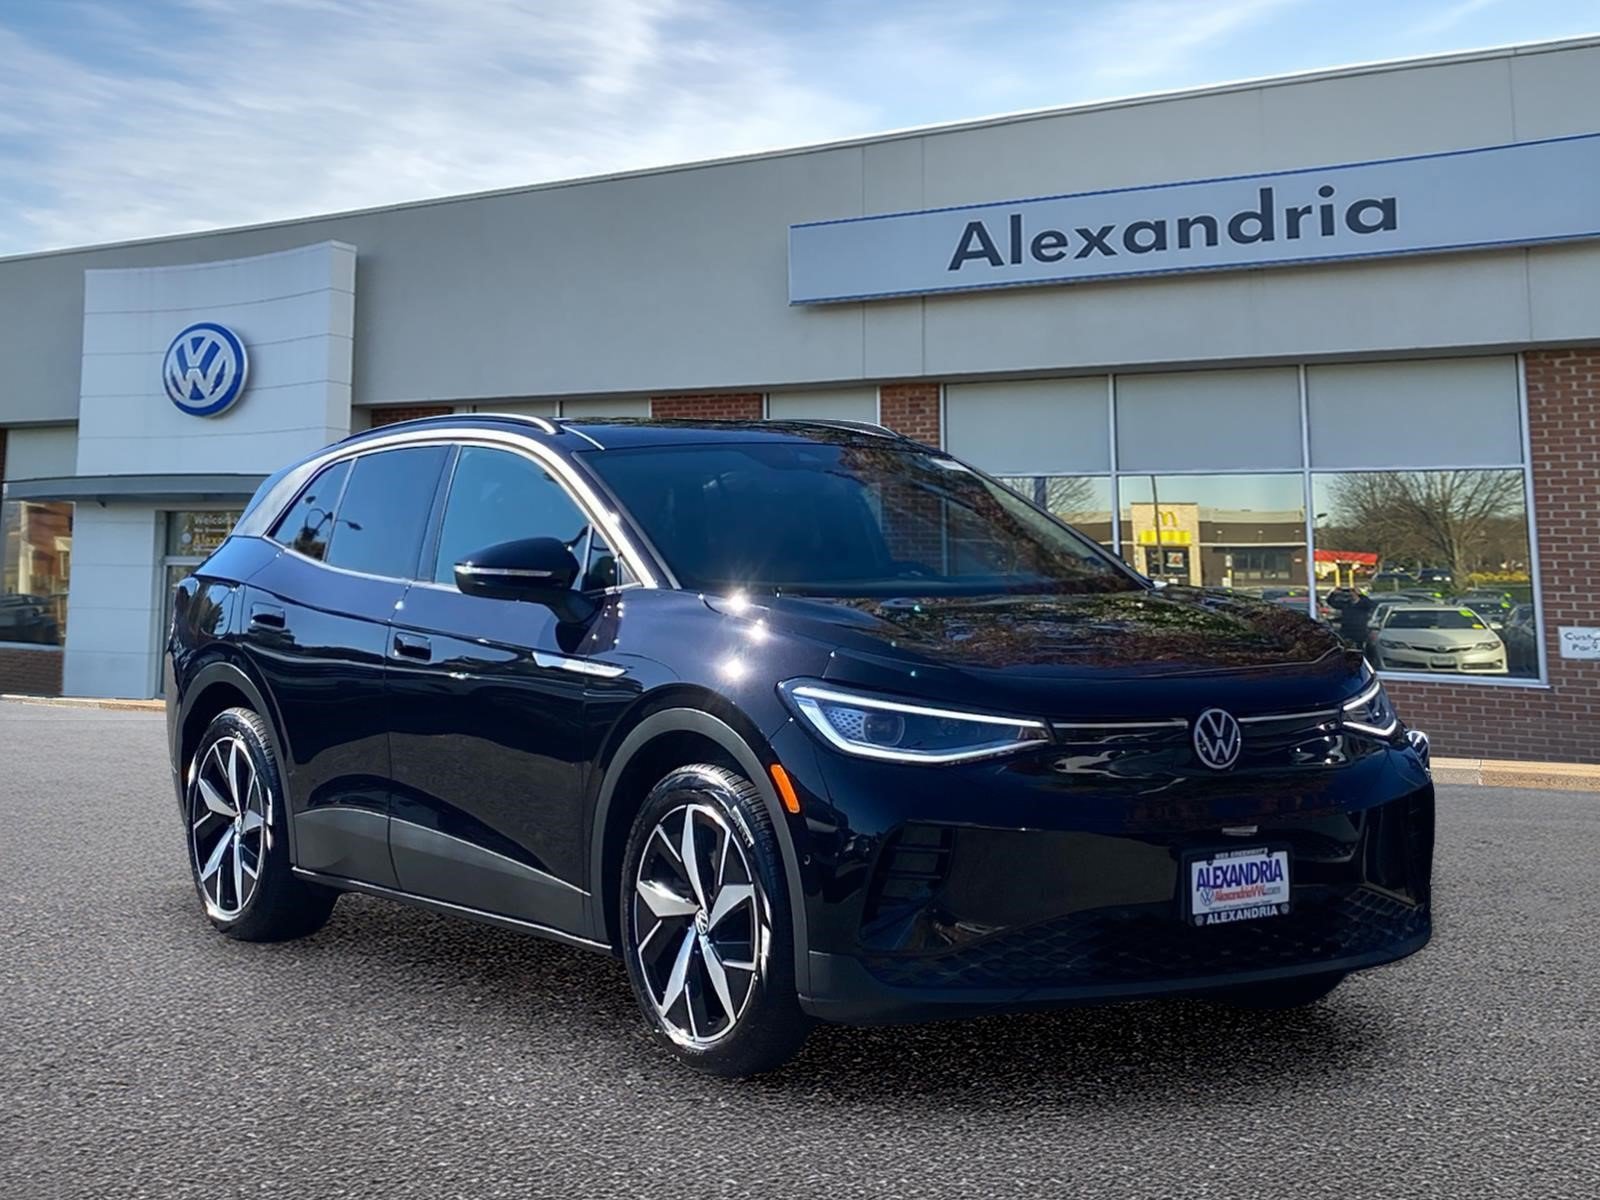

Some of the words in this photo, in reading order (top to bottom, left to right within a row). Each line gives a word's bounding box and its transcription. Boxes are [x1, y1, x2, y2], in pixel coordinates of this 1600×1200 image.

[947, 184, 1398, 271] Alexandria
[1197, 859, 1283, 891] ALEXANDRIA
[1207, 905, 1278, 924] ALEXANDRIA
